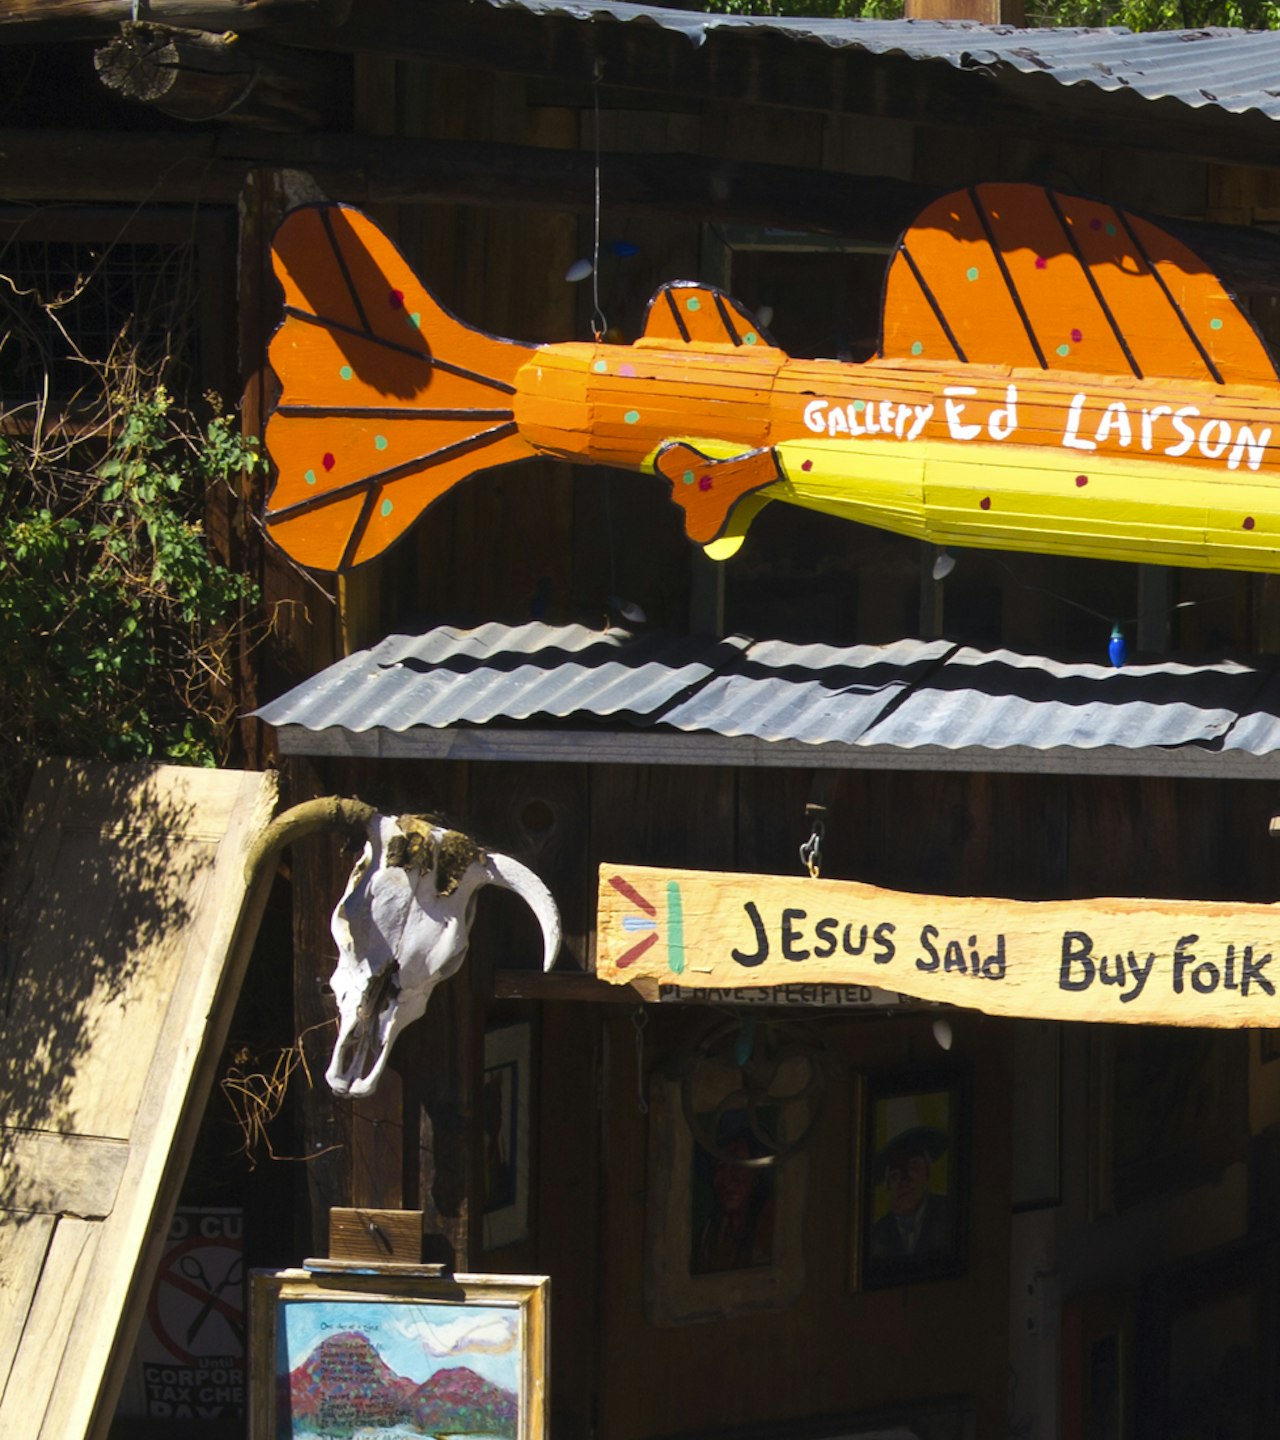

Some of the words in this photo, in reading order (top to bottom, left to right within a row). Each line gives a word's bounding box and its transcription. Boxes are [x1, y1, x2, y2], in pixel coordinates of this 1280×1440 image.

[943, 384, 1018, 440] Ed
[1059, 931, 1155, 1003] Buy
[200, 1216, 243, 1240] CU
[144, 1368, 243, 1386] CORPOR
[148, 1384, 191, 1402] TAX
[199, 1387, 243, 1403] CHE
